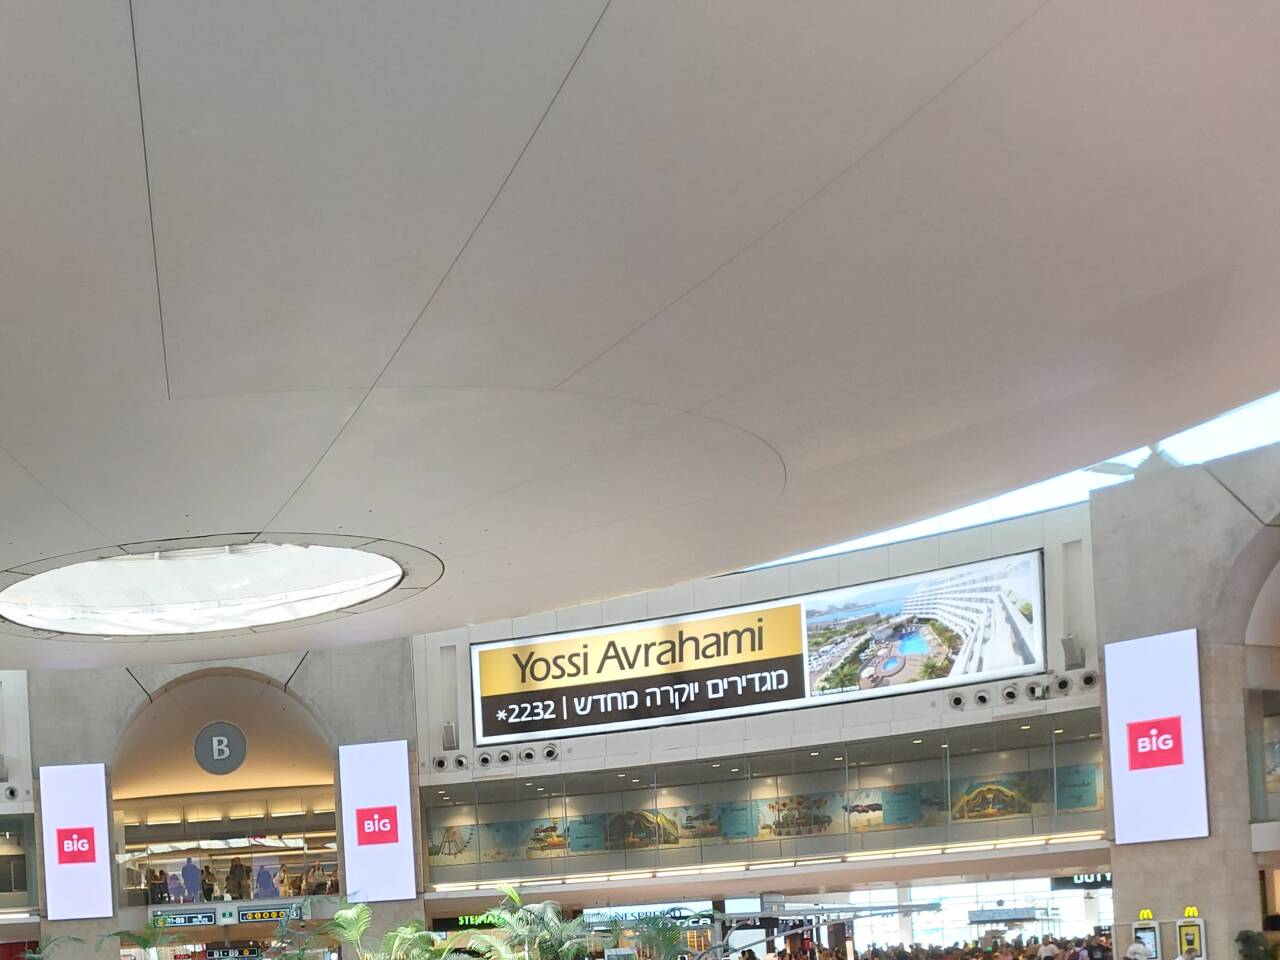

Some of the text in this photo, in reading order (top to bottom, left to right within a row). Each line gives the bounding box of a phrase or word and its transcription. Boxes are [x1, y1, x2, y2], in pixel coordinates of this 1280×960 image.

[512, 618, 764, 684] Yossi Avrahami
[645, 682, 700, 710] יוקרה
[707, 669, 788, 701] מגדירים
[574, 689, 638, 716] מחדש
[212, 736, 231, 760] B
